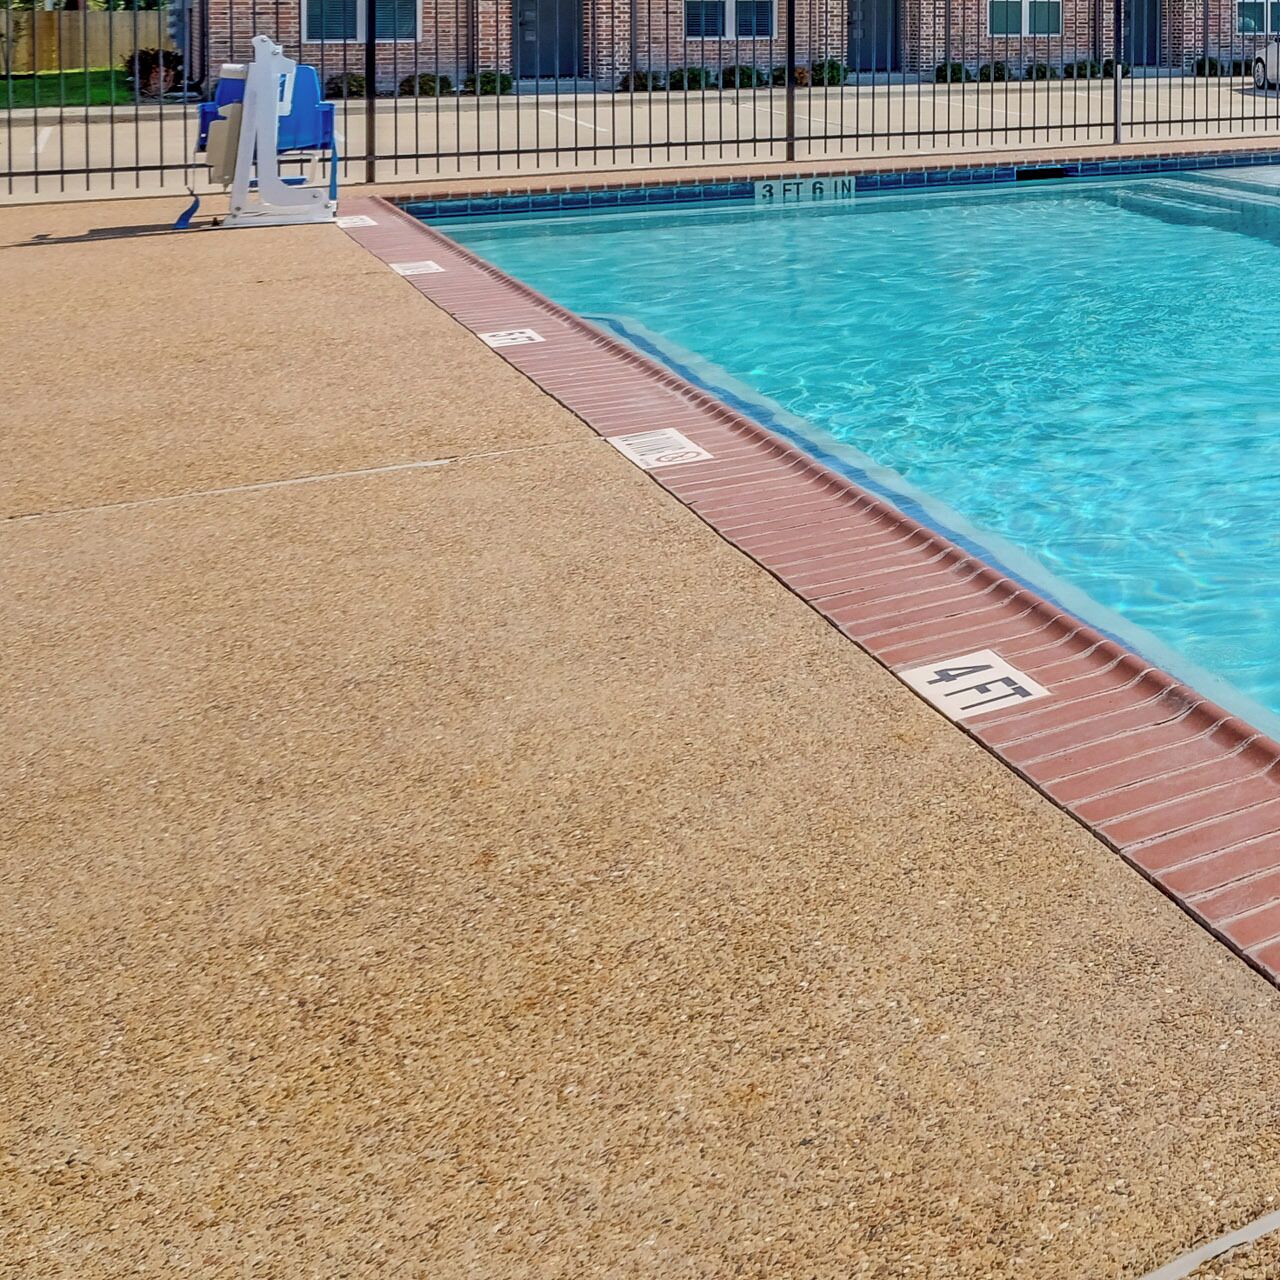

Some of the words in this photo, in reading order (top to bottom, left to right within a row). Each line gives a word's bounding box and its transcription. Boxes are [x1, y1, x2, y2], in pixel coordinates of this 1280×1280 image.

[762, 184, 774, 199] 3
[782, 182, 804, 197] FT
[812, 181, 824, 196] 6
[834, 179, 852, 194] IN
[926, 664, 994, 686] 4
[944, 676, 1033, 711] FT
